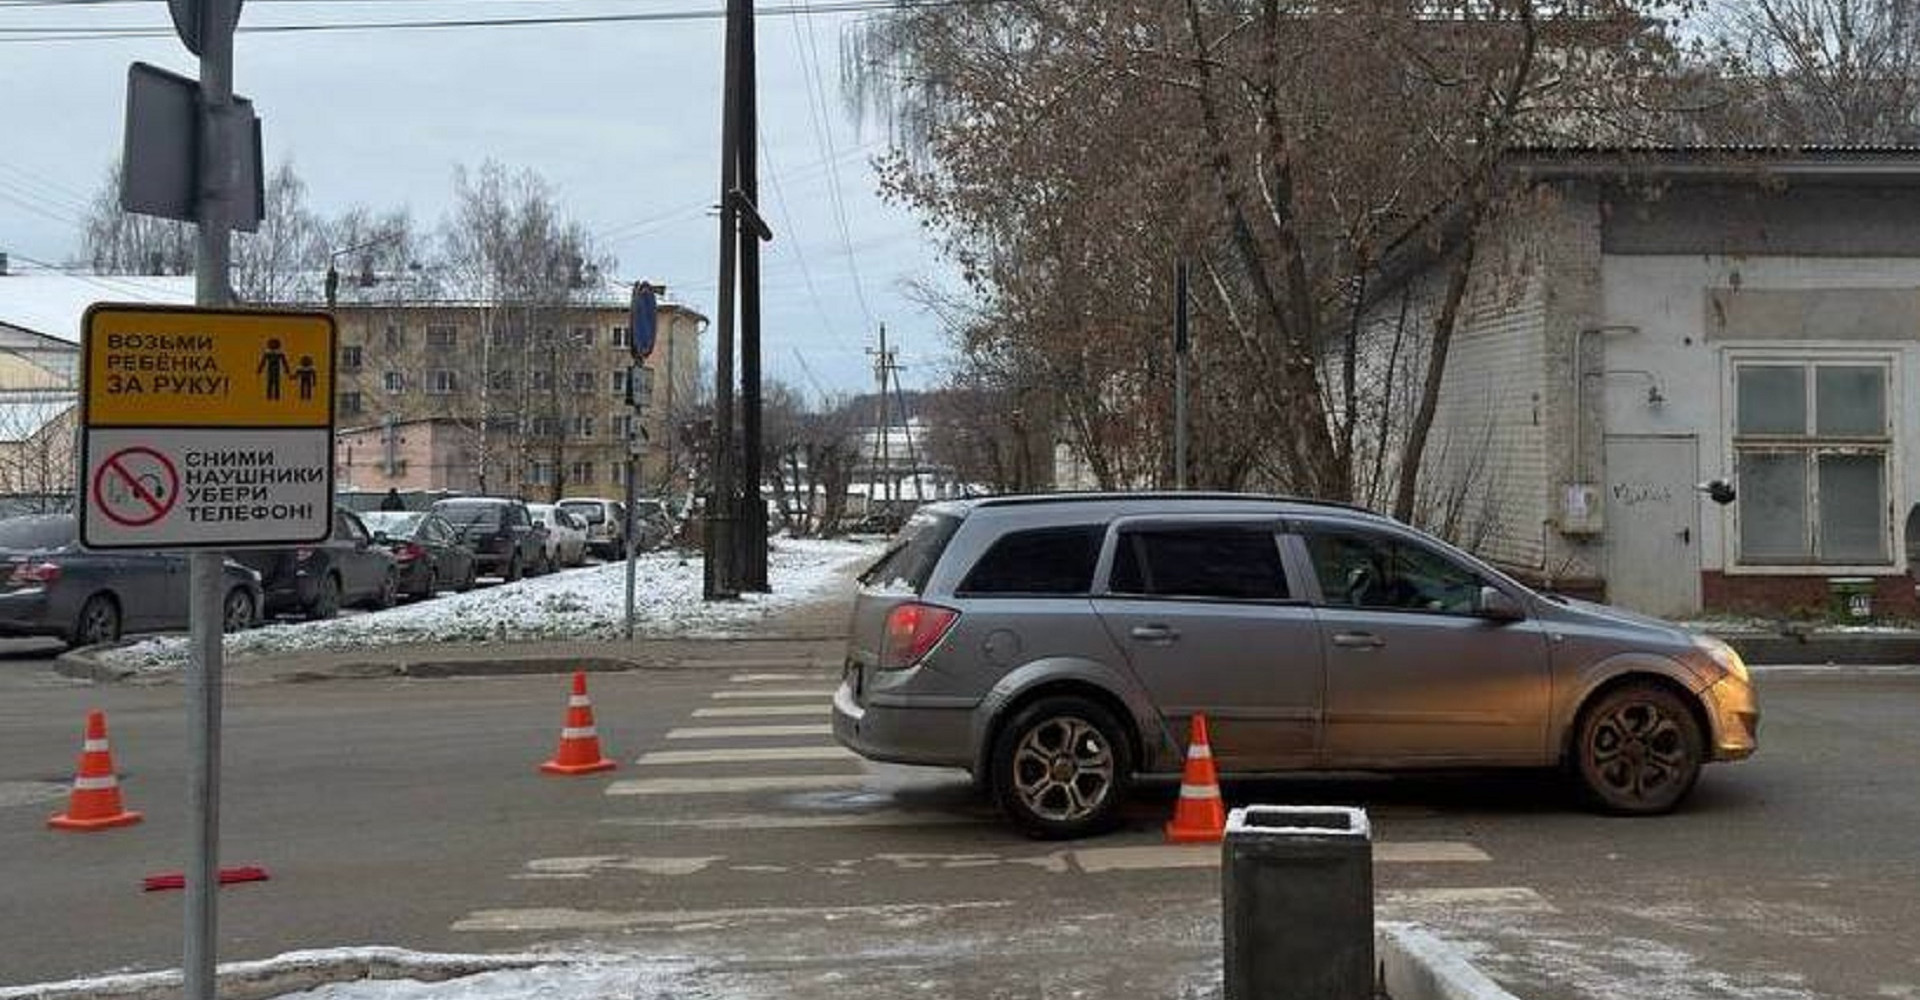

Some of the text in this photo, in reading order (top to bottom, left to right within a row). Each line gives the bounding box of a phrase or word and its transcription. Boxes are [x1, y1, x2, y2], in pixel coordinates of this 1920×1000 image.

[107, 334, 213, 350] ВОЗЬМИ
[107, 352, 217, 371] РЕБЁНКА
[107, 376, 230, 397] ЗА РУКУ!
[185, 451, 274, 467] СНИМИ
[185, 468, 324, 485] НАУШНИКИ
[186, 486, 268, 503] УБЕРИ
[185, 504, 313, 522] ТЕЛЕФОН!
